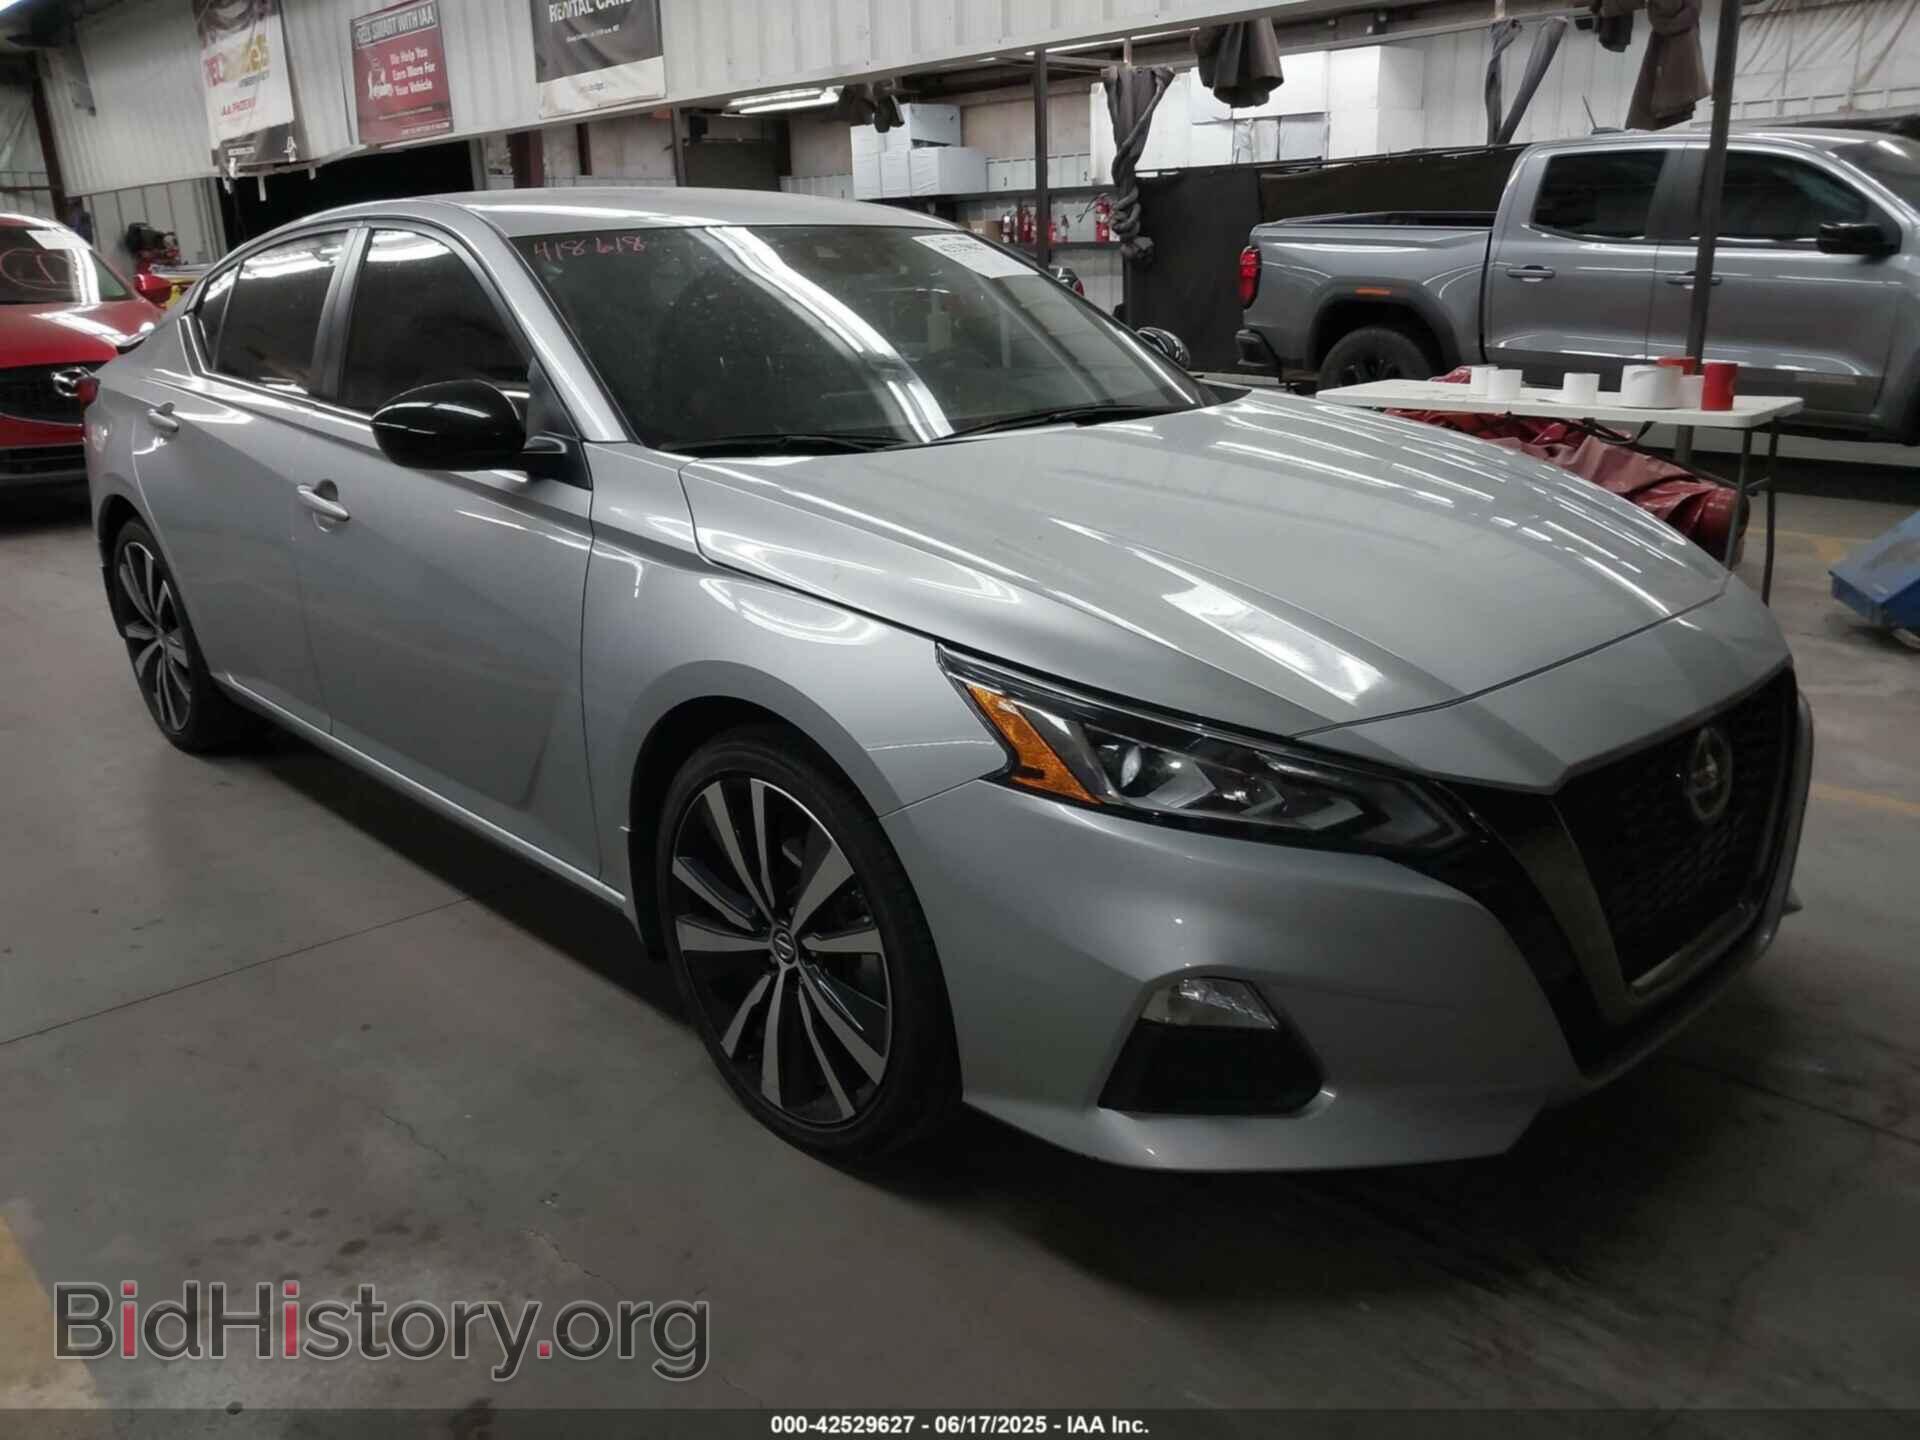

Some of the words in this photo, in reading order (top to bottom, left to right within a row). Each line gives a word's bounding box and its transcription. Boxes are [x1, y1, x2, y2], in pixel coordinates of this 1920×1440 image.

[398, 11, 418, 32] WITH
[418, 5, 434, 26] IAA
[547, 0, 594, 22] RENTAL
[400, 49, 416, 63] Help
[408, 79, 433, 93] Vehicle
